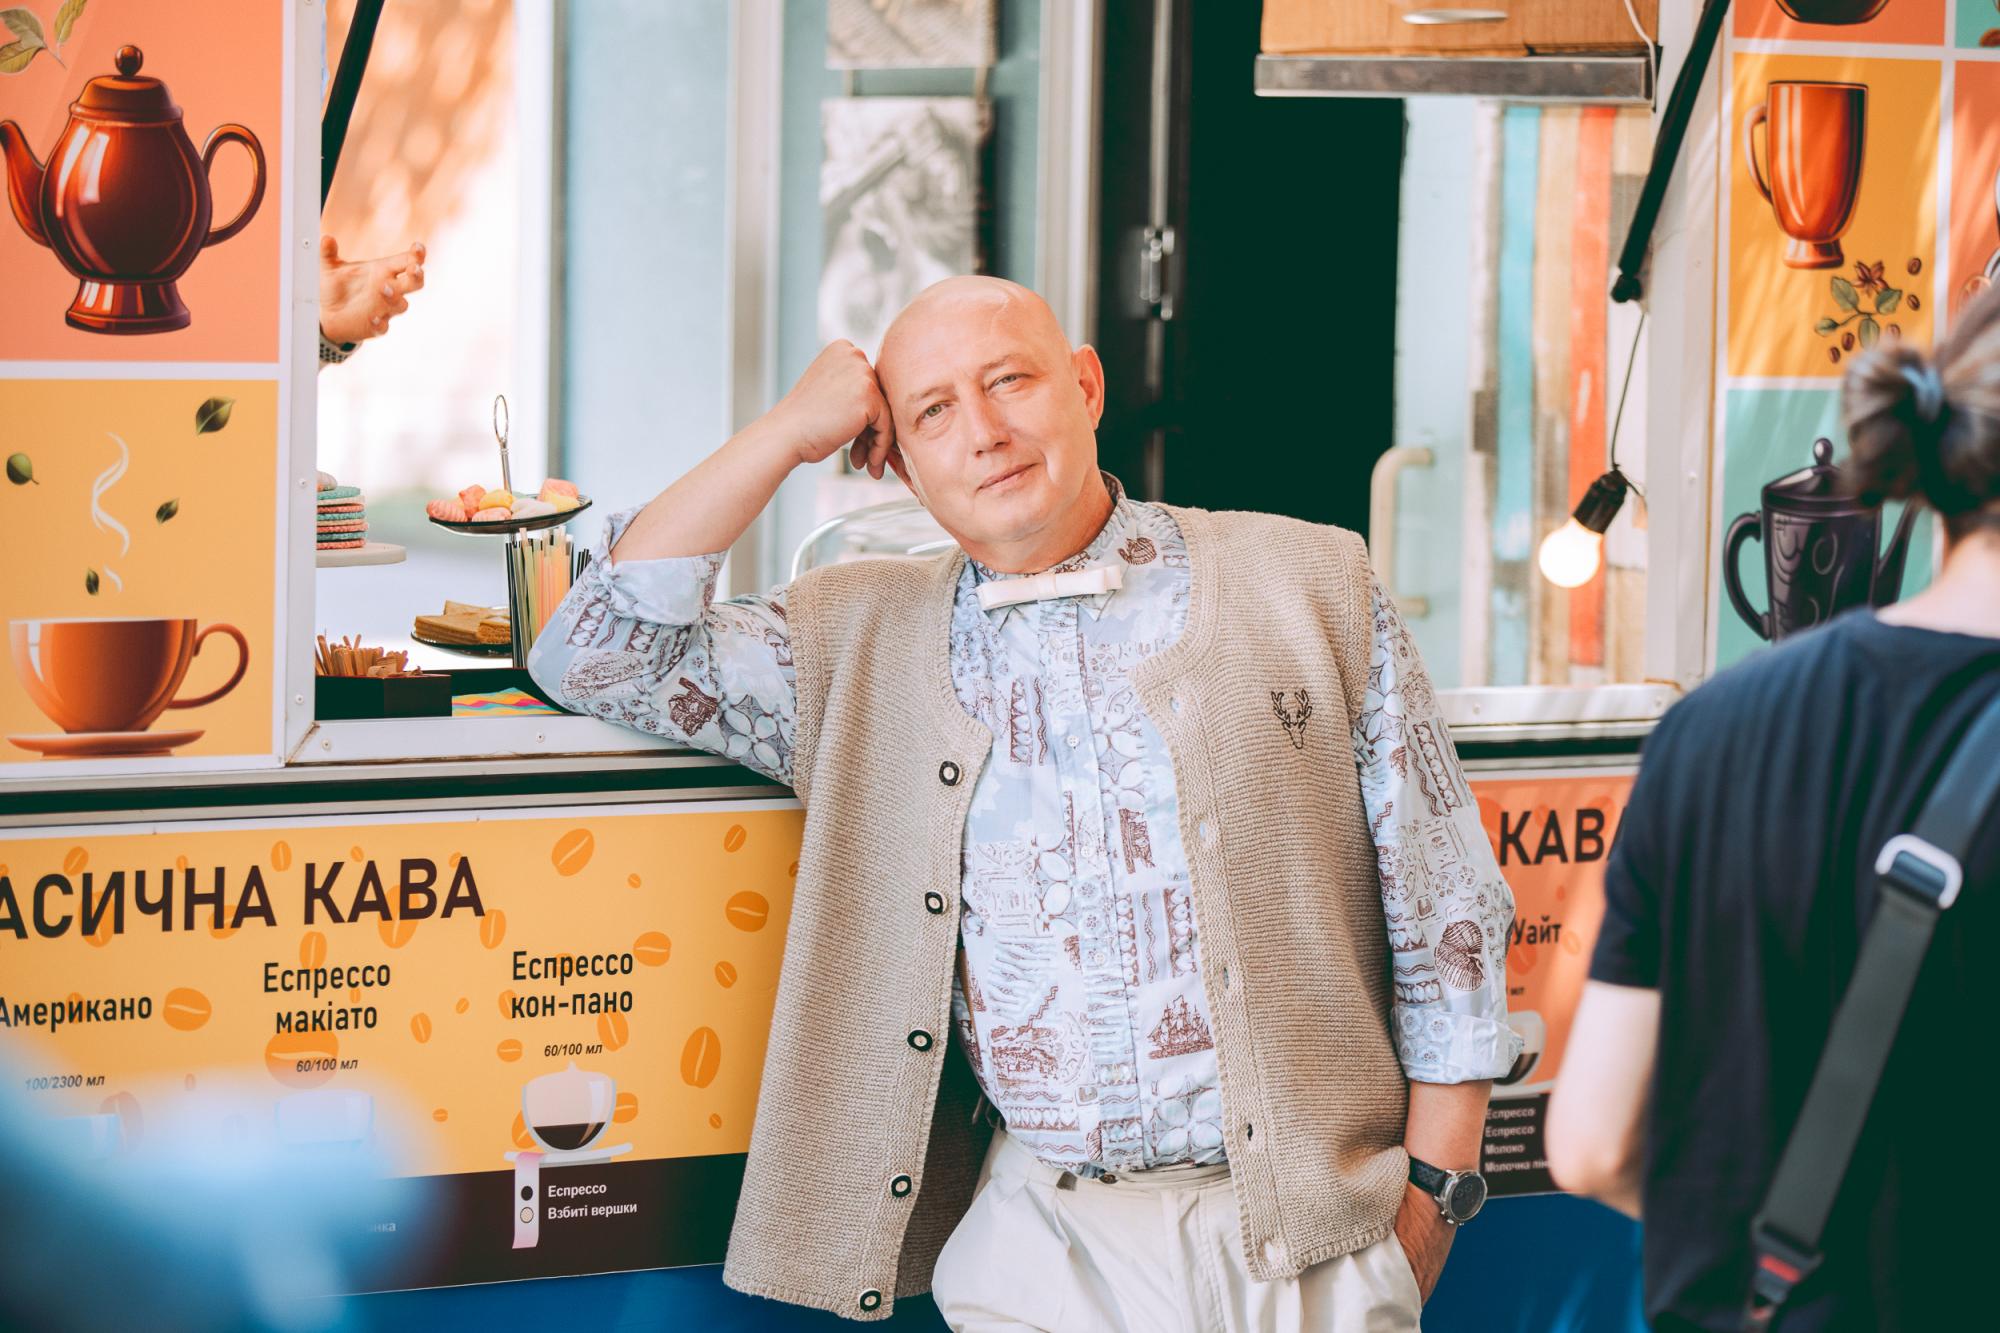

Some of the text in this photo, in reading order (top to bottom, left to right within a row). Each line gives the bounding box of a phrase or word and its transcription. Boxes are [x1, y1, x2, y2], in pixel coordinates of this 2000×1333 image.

[1500, 806, 1626, 866] КАВ
[303, 856, 486, 925] КАВА
[1513, 915, 1562, 945] Уайт
[264, 962, 391, 998] Еспрессо
[513, 951, 633, 986] Еспрессо
[0, 997, 152, 1033] Американо
[276, 1001, 377, 1034] макіато
[512, 991, 633, 1018] кон-пано
[544, 1043, 603, 1057] 60/100 мл
[296, 1058, 358, 1072] 60/100 мл
[86, 1076, 105, 1087] мл
[1485, 1126, 1536, 1138] Еспрессо
[548, 1184, 607, 1198] Еспрессо
[548, 1203, 638, 1220] Взбиті вершки
